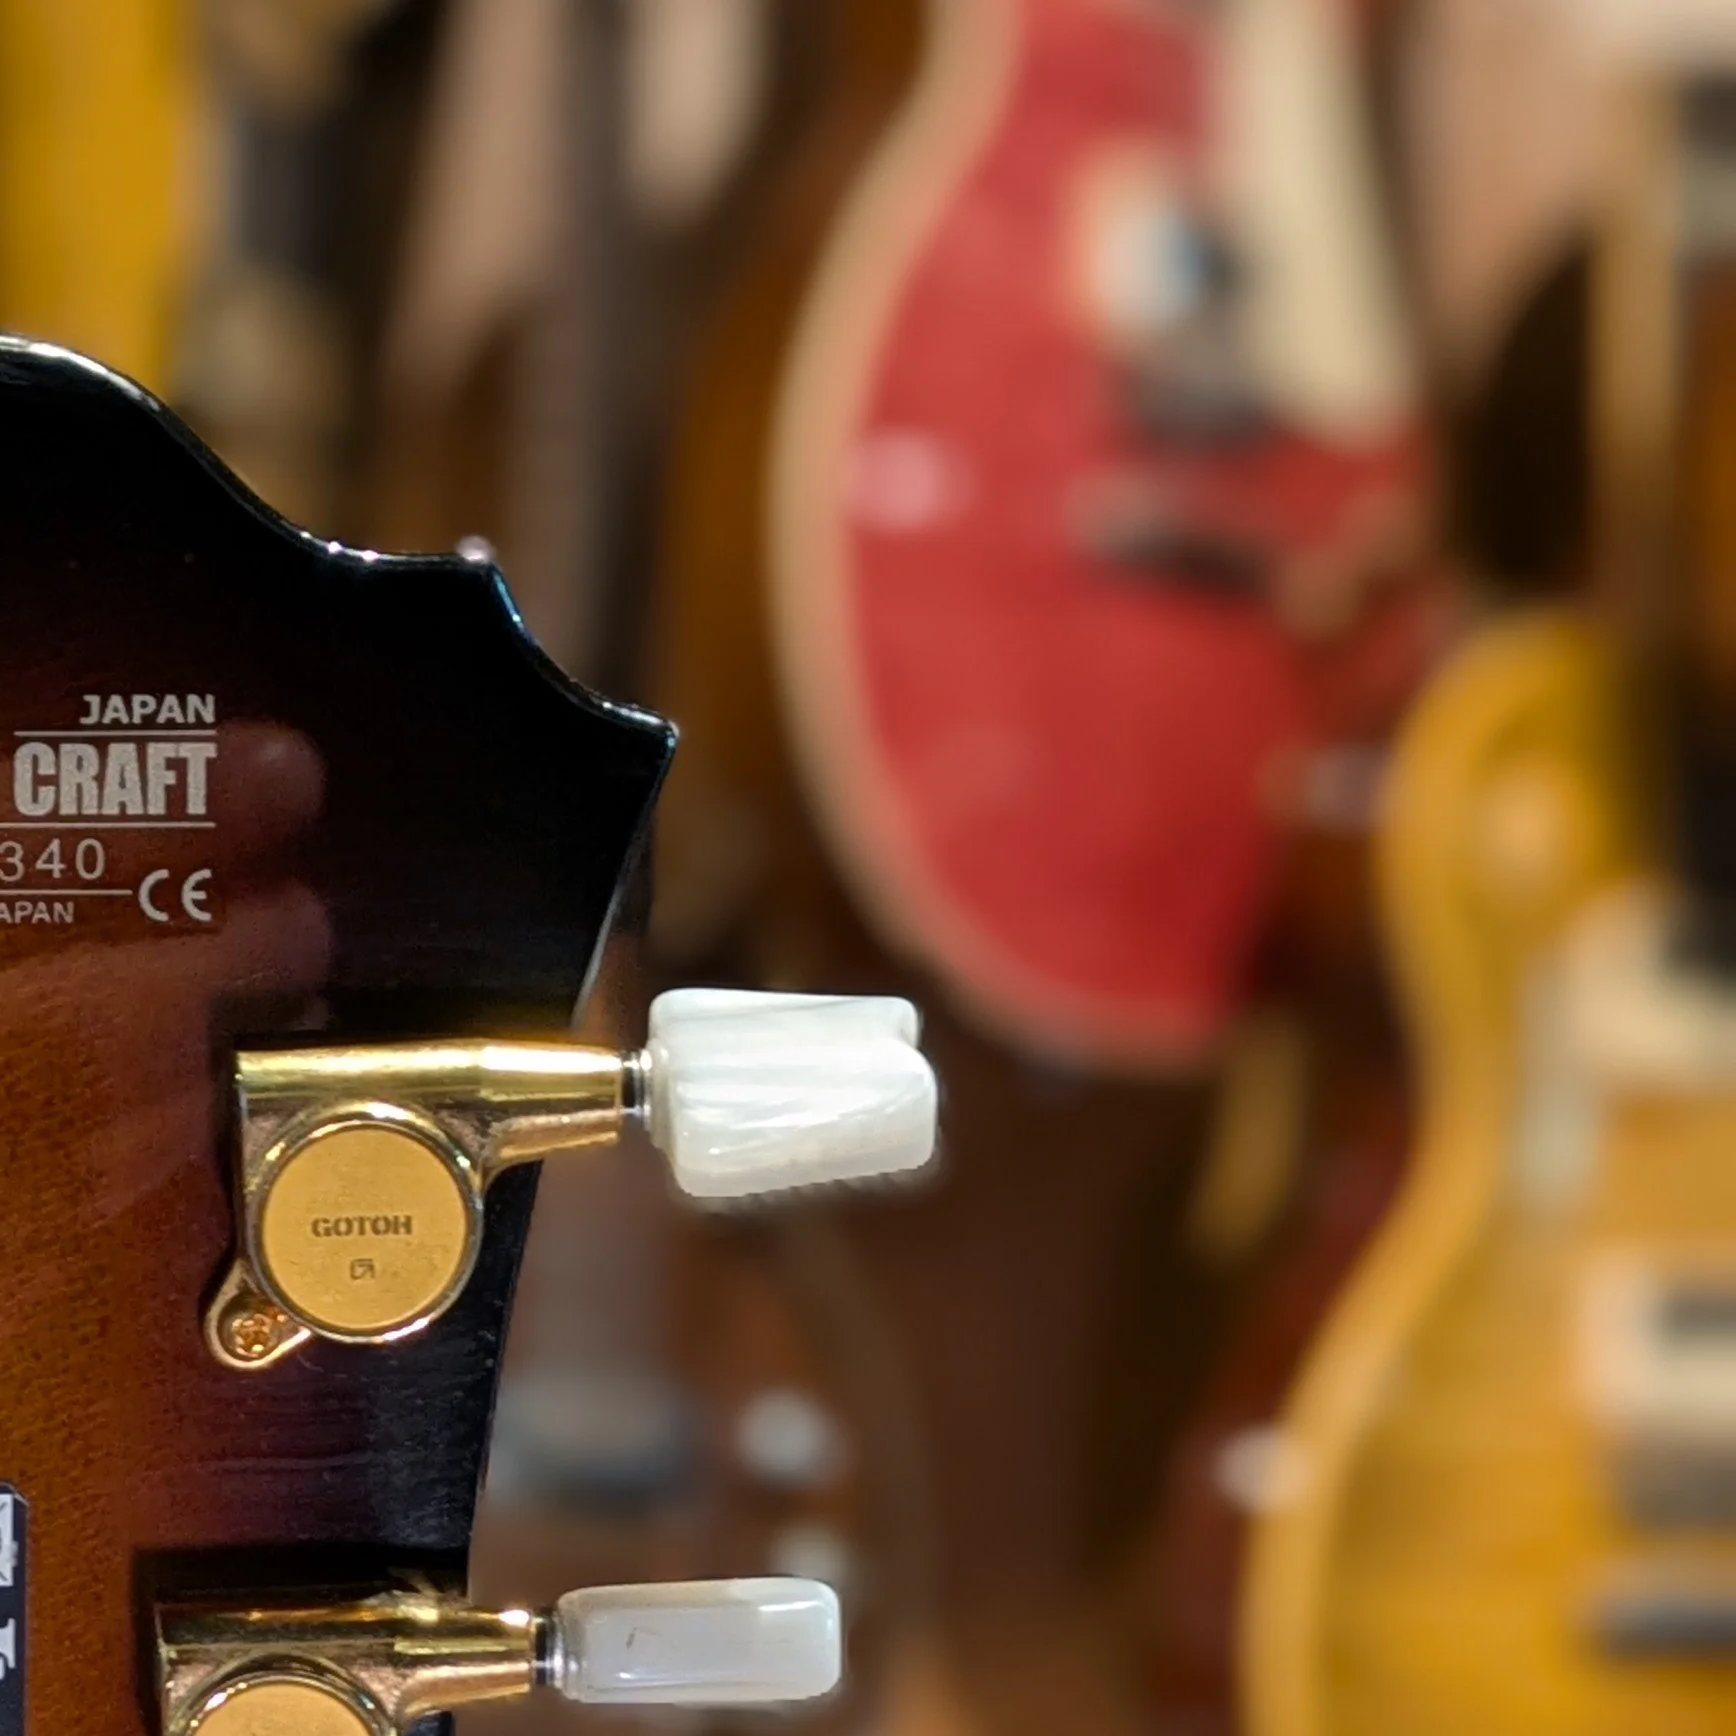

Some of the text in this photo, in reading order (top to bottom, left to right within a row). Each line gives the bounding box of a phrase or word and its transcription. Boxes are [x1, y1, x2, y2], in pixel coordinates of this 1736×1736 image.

[80, 694, 216, 725] JAPAN
[13, 741, 217, 816] CRAFT
[311, 1215, 413, 1239] GOTOH
